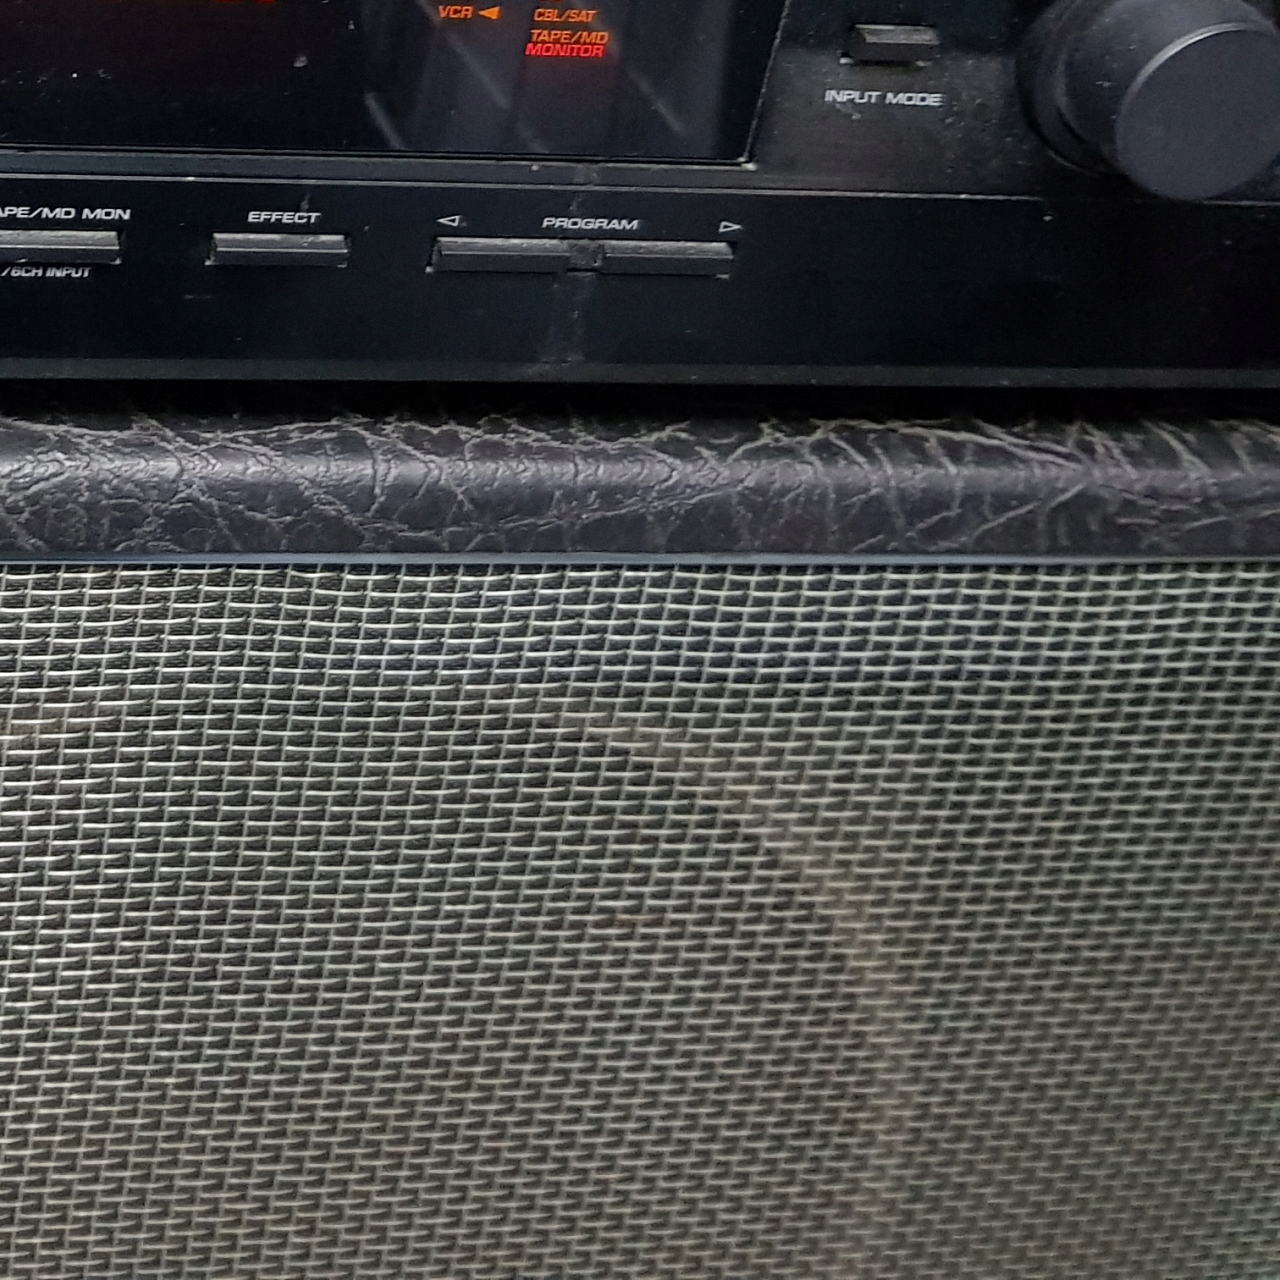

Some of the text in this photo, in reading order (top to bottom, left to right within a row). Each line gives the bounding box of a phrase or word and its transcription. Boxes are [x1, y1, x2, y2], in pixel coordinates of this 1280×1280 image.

[438, 5, 475, 20] VCR
[533, 7, 598, 24] CBL/SAT
[530, 28, 610, 45] TAPE/MD
[524, 42, 606, 58] MONITOR
[824, 89, 944, 107] INPUT MODE
[81, 207, 132, 221] MON
[247, 210, 320, 224] EFFECT
[540, 216, 640, 231] PROGRAM
[45, 266, 92, 279] INPUT
